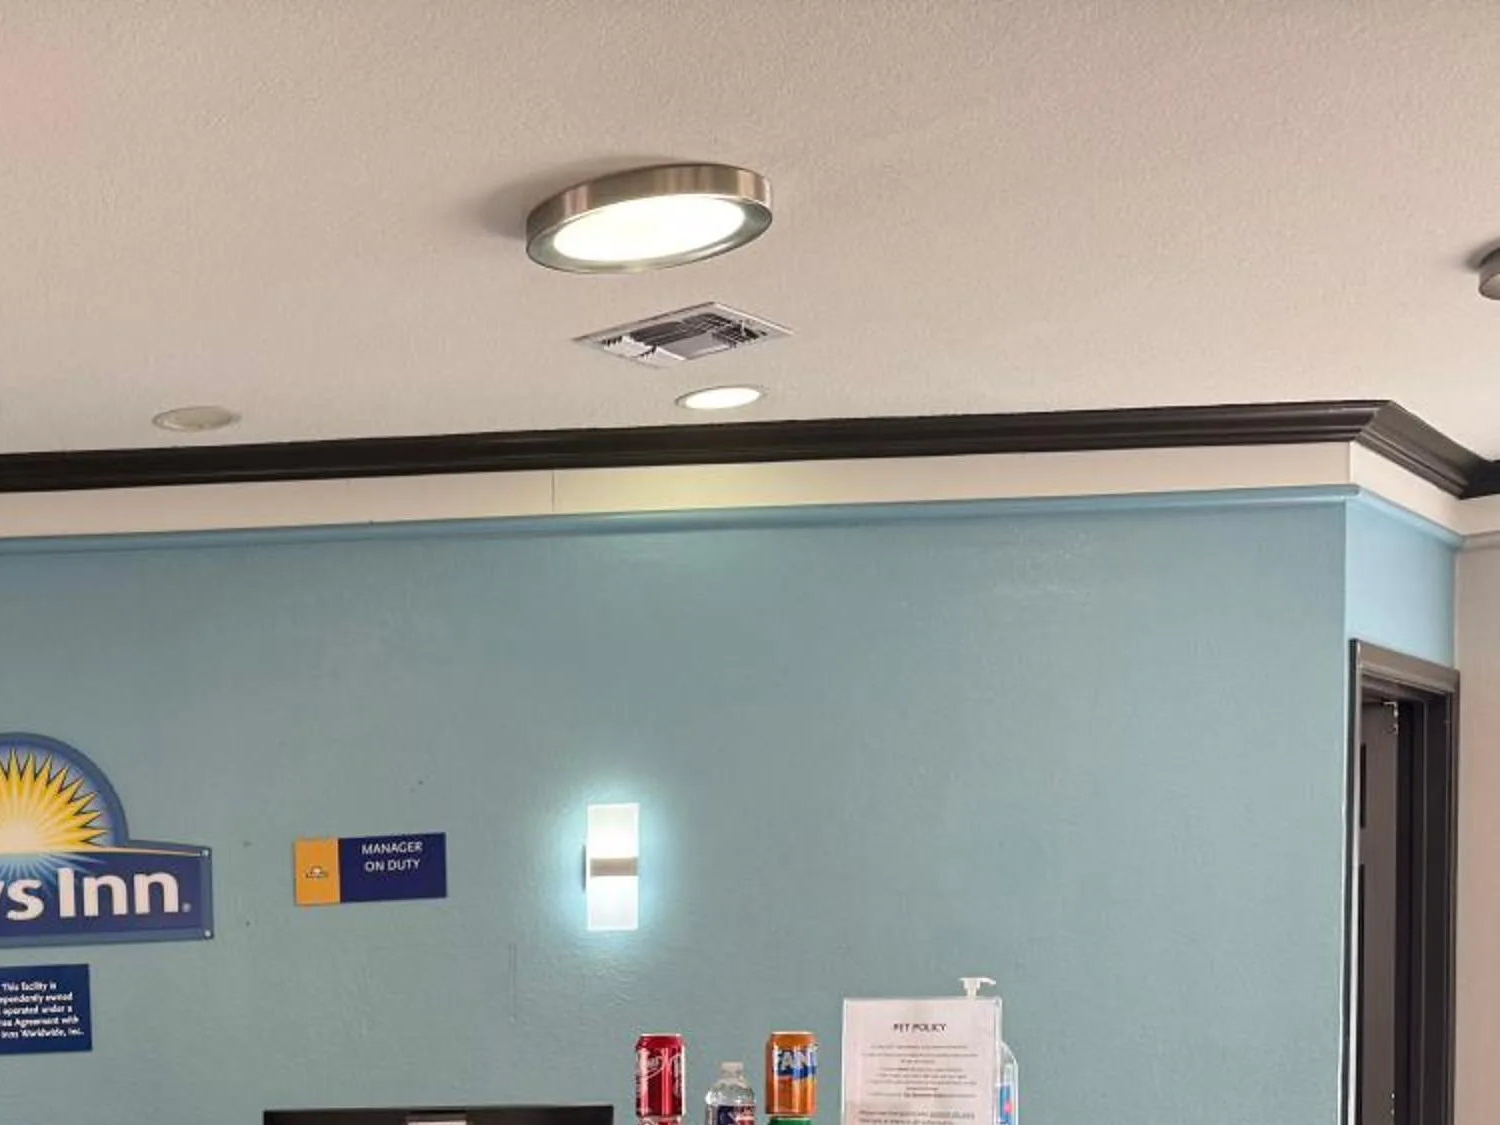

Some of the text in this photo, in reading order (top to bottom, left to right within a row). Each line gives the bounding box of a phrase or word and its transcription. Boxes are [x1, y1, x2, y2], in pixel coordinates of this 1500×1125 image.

[361, 841, 424, 855] MANAGER
[364, 858, 421, 873] ON DUTY
[57, 867, 179, 918] Inn
[2, 981, 57, 993] This facility is
[45, 992, 73, 1002] owned
[2, 1005, 39, 1018] operated
[41, 1004, 65, 1014] under
[14, 1017, 59, 1030] Agreement
[60, 1015, 80, 1024] with
[893, 1023, 947, 1033] PET POLICY
[772, 1043, 818, 1070] FANT
